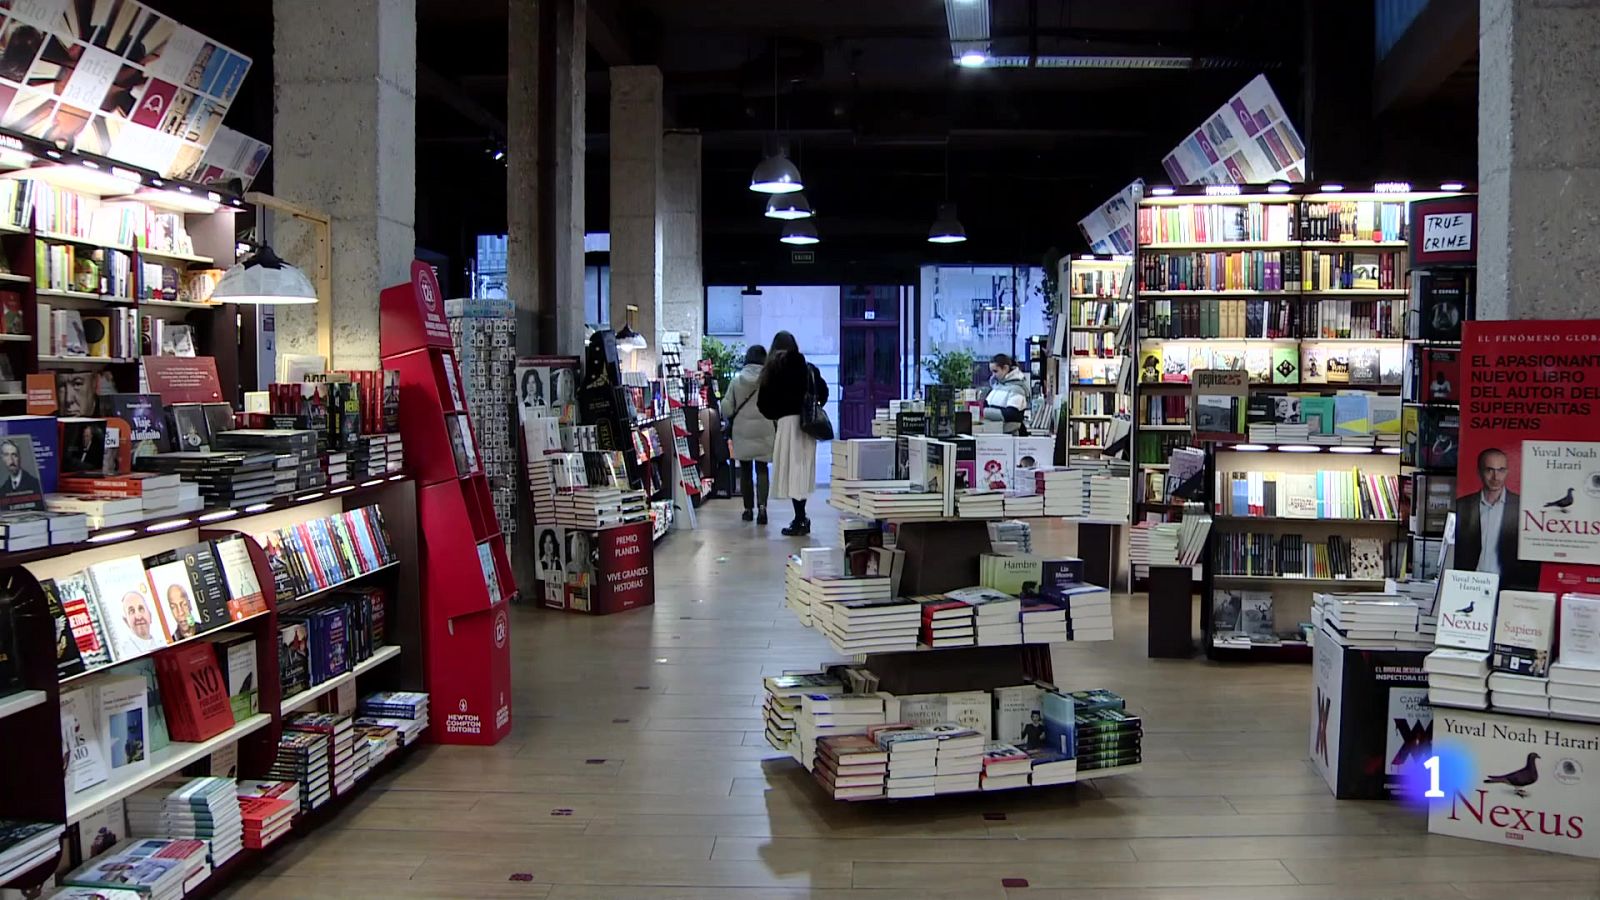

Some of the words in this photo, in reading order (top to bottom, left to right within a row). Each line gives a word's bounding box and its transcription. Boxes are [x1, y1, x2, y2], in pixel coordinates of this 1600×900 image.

[1428, 216, 1463, 232] TRUE
[1424, 235, 1467, 250] CRIME
[1495, 333, 1560, 342] FENÓMENO
[1565, 334, 1600, 342] GLOB
[1471, 355, 1491, 368] EL
[1471, 370, 1527, 383] NUEVO
[1533, 370, 1585, 383] LIBRO
[1470, 385, 1502, 399] DEL
[1506, 386, 1565, 400] AUTOR
[1470, 401, 1591, 416] SUPERVENTAS
[1470, 416, 1541, 430] SAPIENS
[1532, 447, 1560, 457] Yuval
[1566, 448, 1597, 458] Noah
[1547, 460, 1581, 470] Harari
[1523, 510, 1600, 535] Nexus
[615, 535, 638, 545] PREMIO
[614, 545, 640, 557] PLANETA
[1003, 560, 1038, 569] Hambre
[606, 574, 621, 582] VIVE
[622, 566, 649, 578] GRANDES
[613, 579, 643, 592] HISTORIAS
[1459, 582, 1481, 592] Harari
[1442, 613, 1489, 632] Nexus
[1503, 621, 1543, 636] Sapiens
[190, 665, 220, 700] NO
[1375, 674, 1416, 682] INSPECTORA
[1399, 695, 1422, 704] CAR
[447, 726, 480, 734] EDITORES
[1444, 718, 1486, 738] Yuval
[1493, 724, 1537, 744] Noah
[1545, 730, 1598, 750] Harari
[1447, 789, 1583, 839] Nexus
